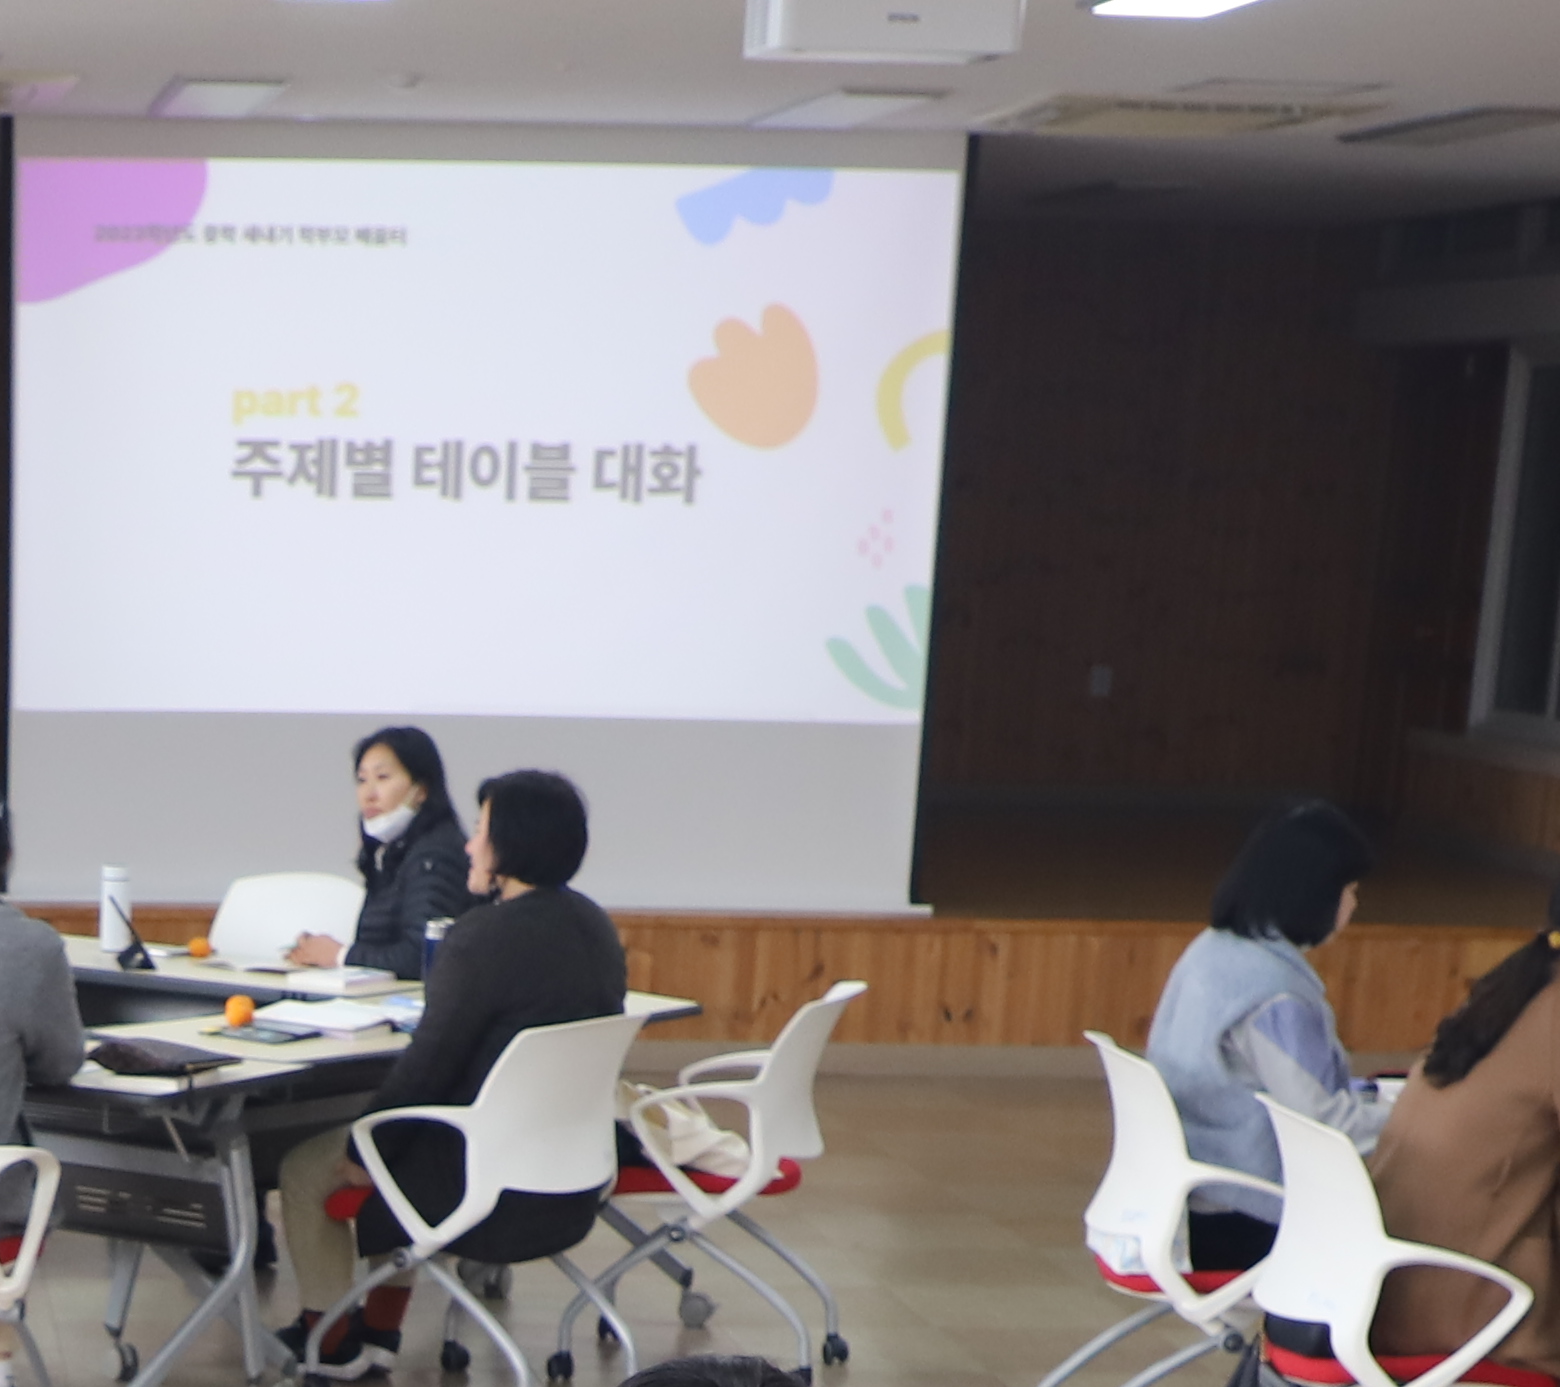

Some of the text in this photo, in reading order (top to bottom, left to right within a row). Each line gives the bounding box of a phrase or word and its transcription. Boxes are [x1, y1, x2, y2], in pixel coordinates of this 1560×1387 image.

[232, 384, 360, 424] part 2
[230, 439, 702, 503] 주제별 테이블 대화
